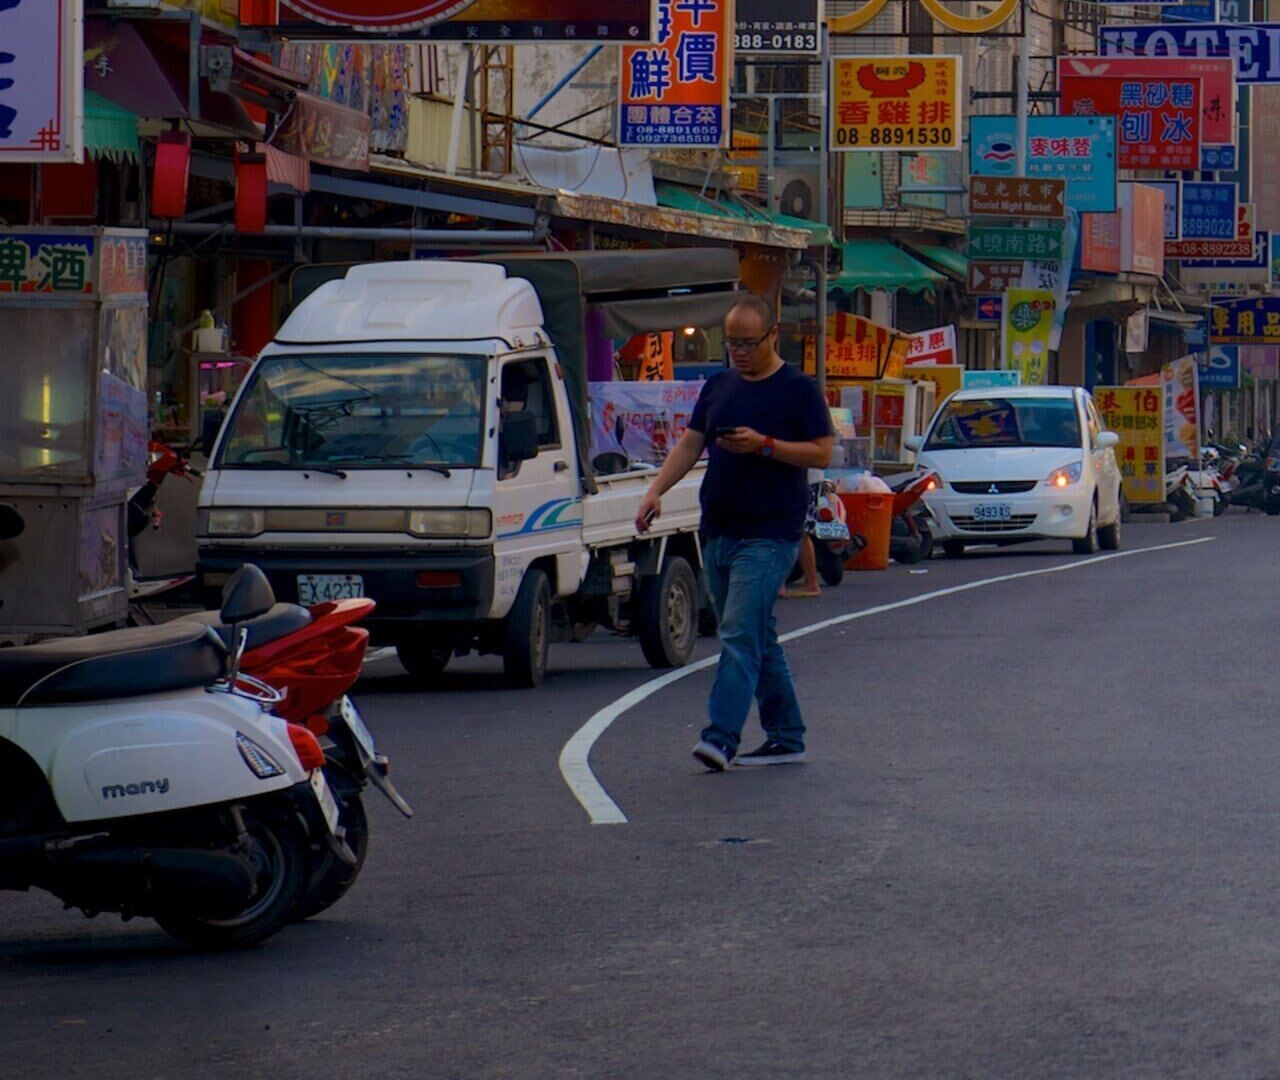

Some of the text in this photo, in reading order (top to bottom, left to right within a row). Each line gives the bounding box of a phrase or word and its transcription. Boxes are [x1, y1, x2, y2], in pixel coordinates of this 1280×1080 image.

[1119, 82, 1195, 109] 黑砂糖
[626, 107, 717, 125] 團體合菜
[838, 101, 952, 125] 香雞排
[1119, 110, 1194, 144] 刨冰
[1029, 136, 1092, 158] 麥味登
[972, 181, 1055, 199] 觀光夜市
[972, 200, 1052, 212] Tourist Night Market
[982, 233, 1048, 253] 曉南路
[102, 776, 170, 800] many
